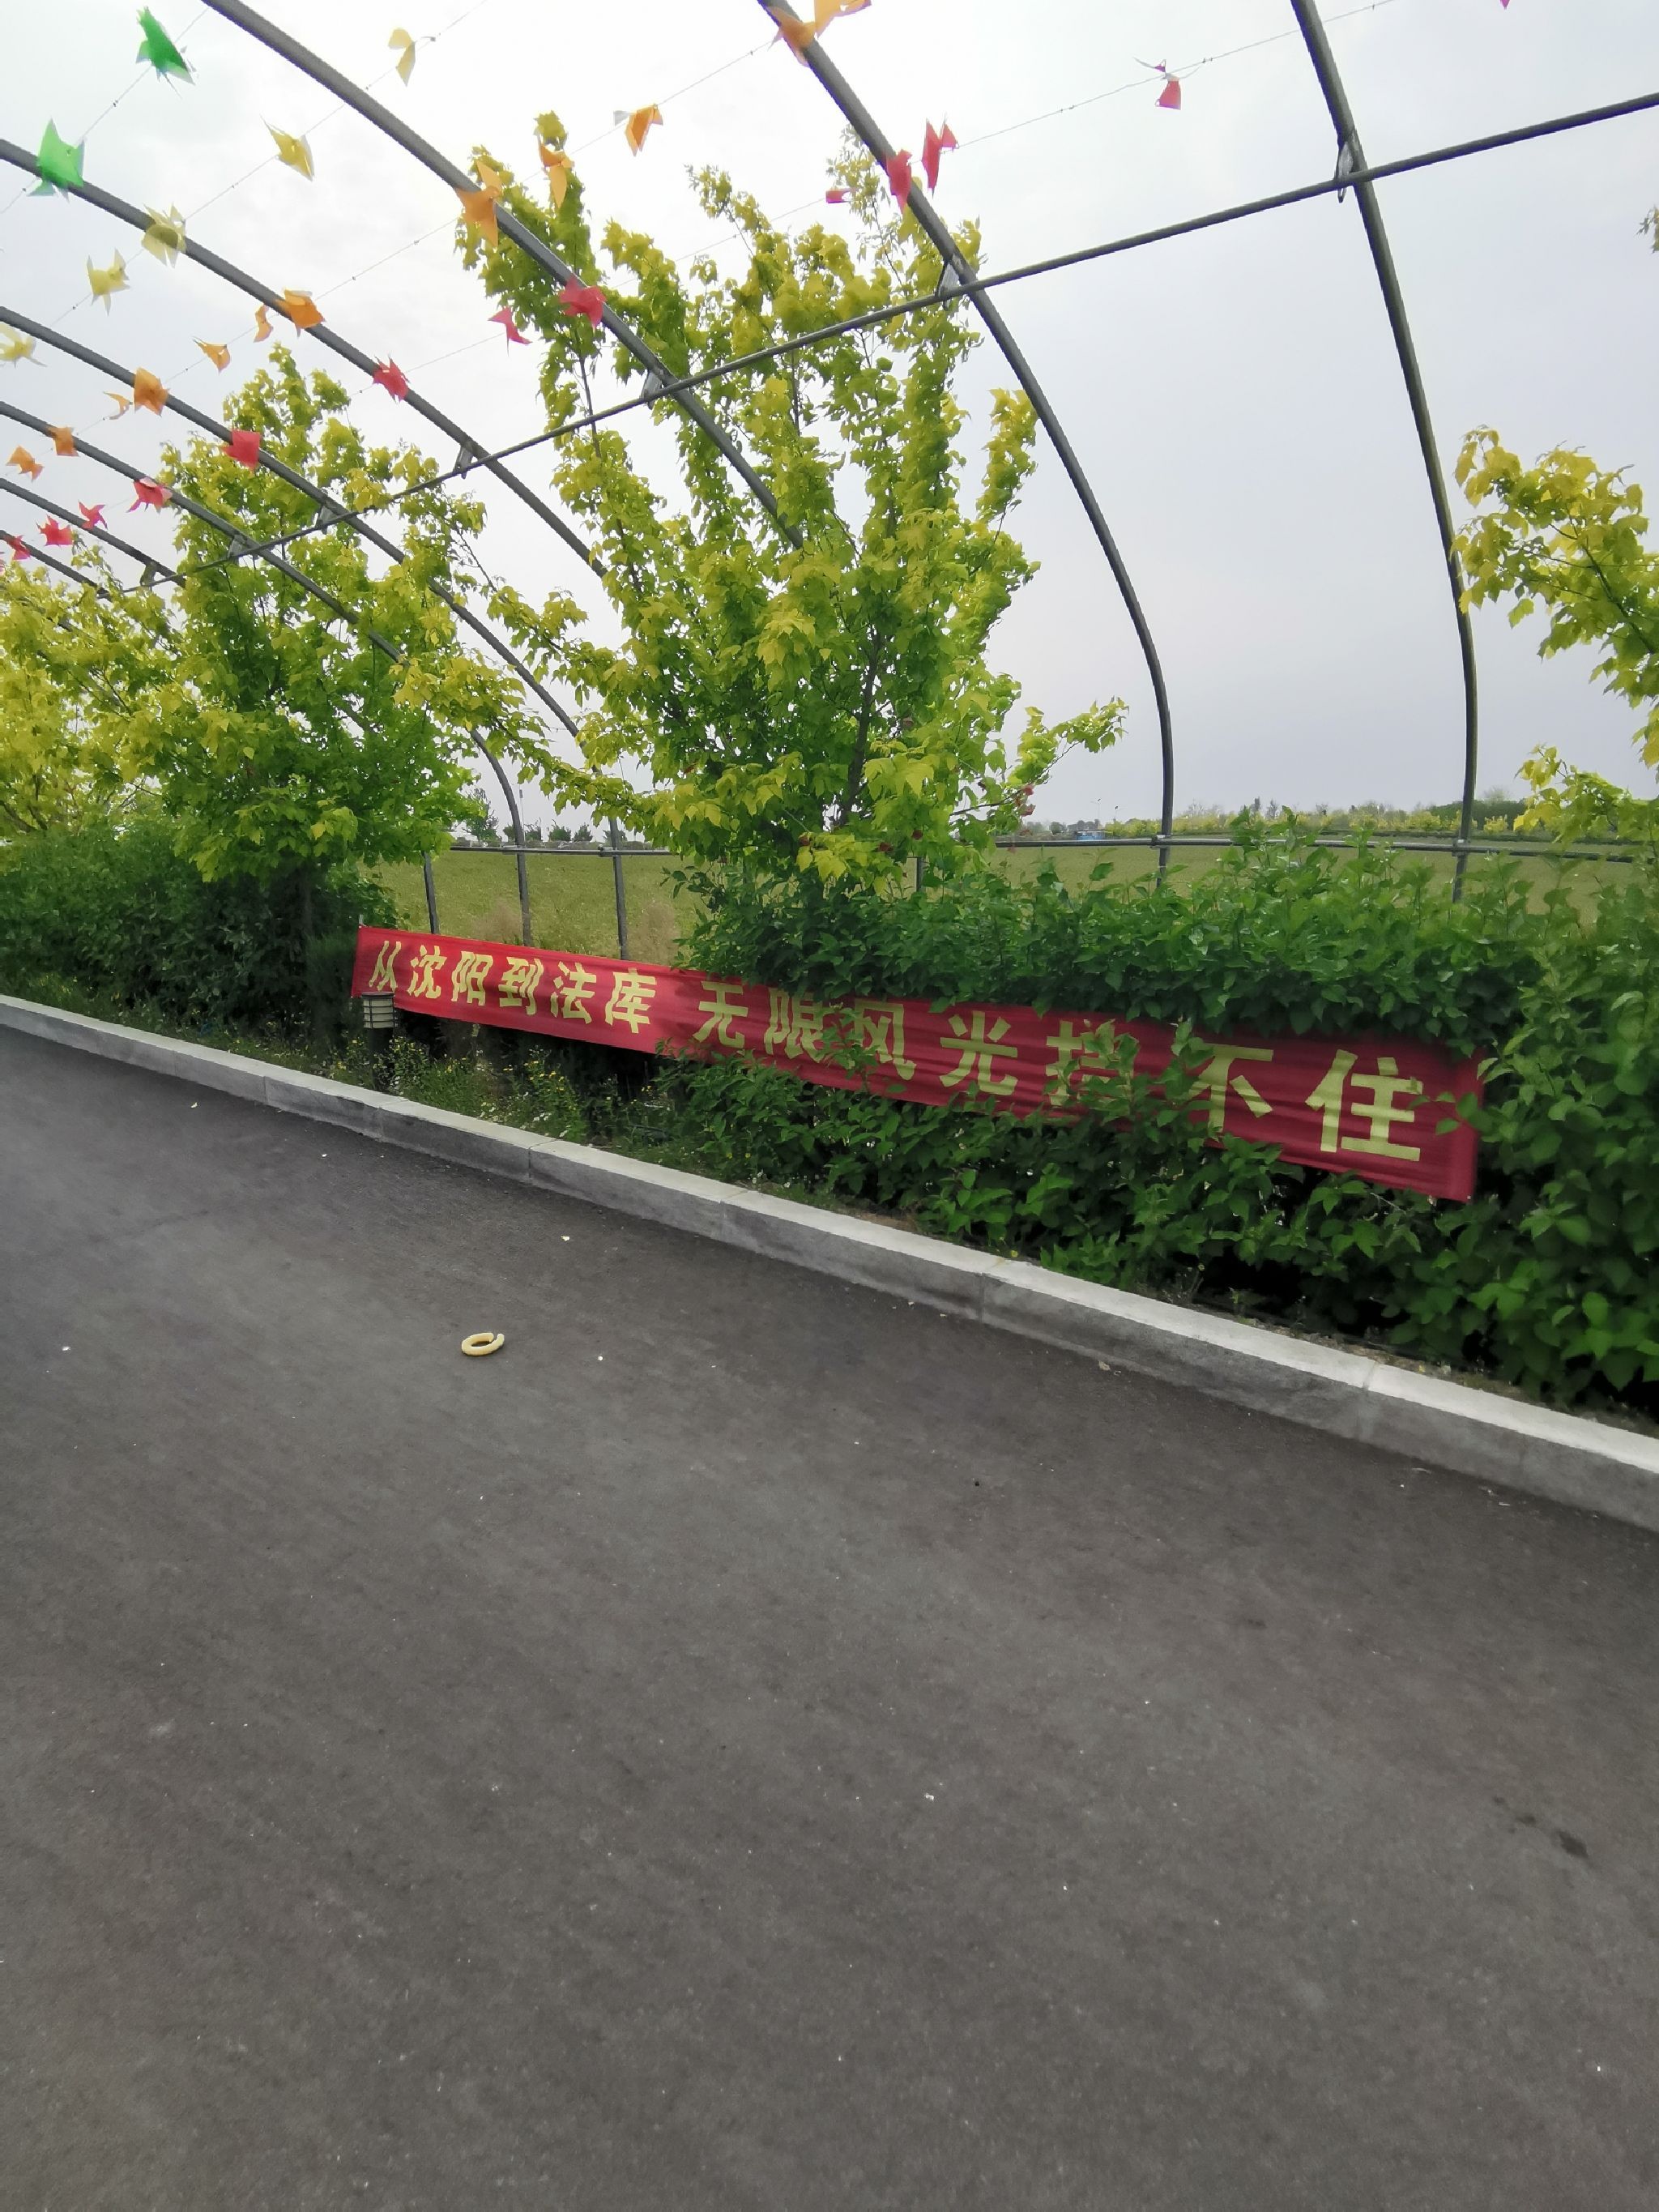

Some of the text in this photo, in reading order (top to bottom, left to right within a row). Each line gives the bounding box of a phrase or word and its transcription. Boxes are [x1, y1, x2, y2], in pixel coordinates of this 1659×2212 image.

[369, 940, 657, 1034] 从沈阳到法库
